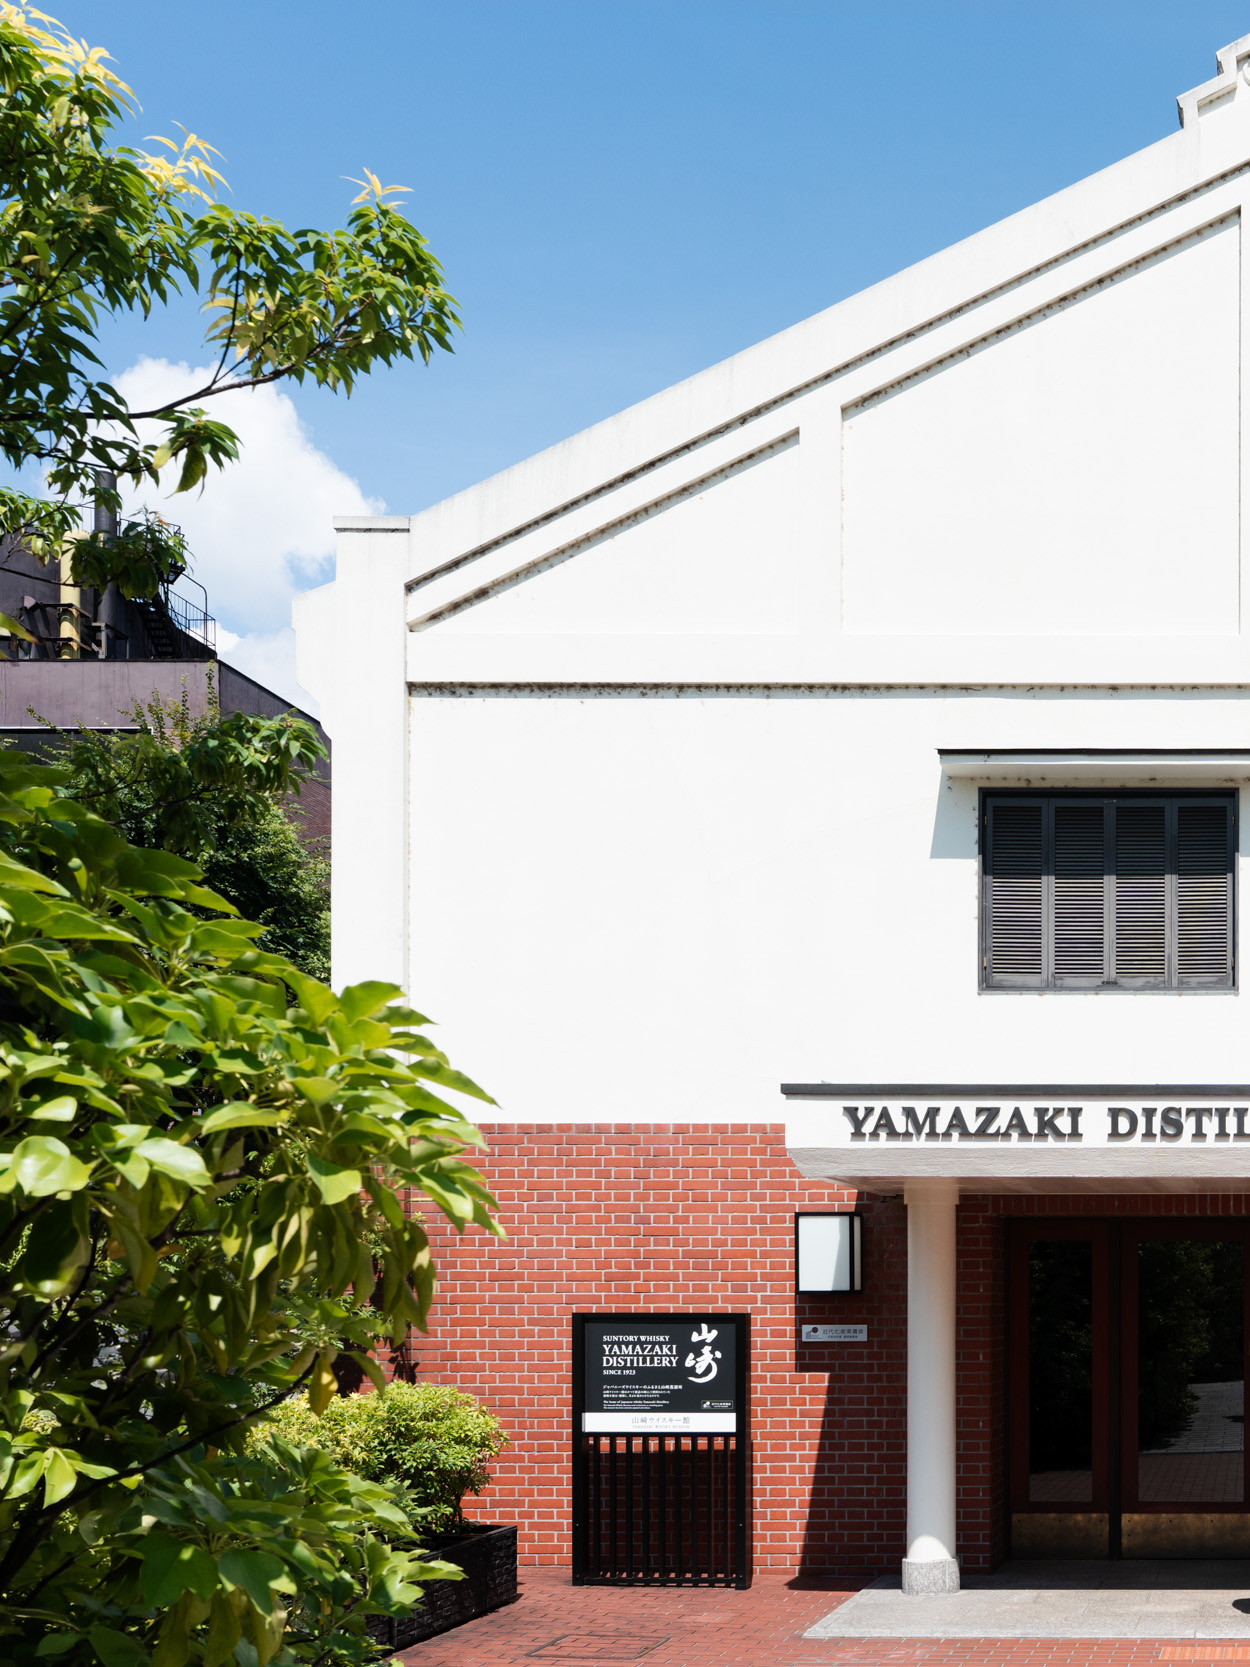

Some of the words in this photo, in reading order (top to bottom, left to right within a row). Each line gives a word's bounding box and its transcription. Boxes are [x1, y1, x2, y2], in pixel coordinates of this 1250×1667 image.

[842, 1106, 1083, 1139] YAMAZAKI
[602, 1344, 677, 1355] YAMAZAKI
[602, 1356, 679, 1367] DISTILLERY
